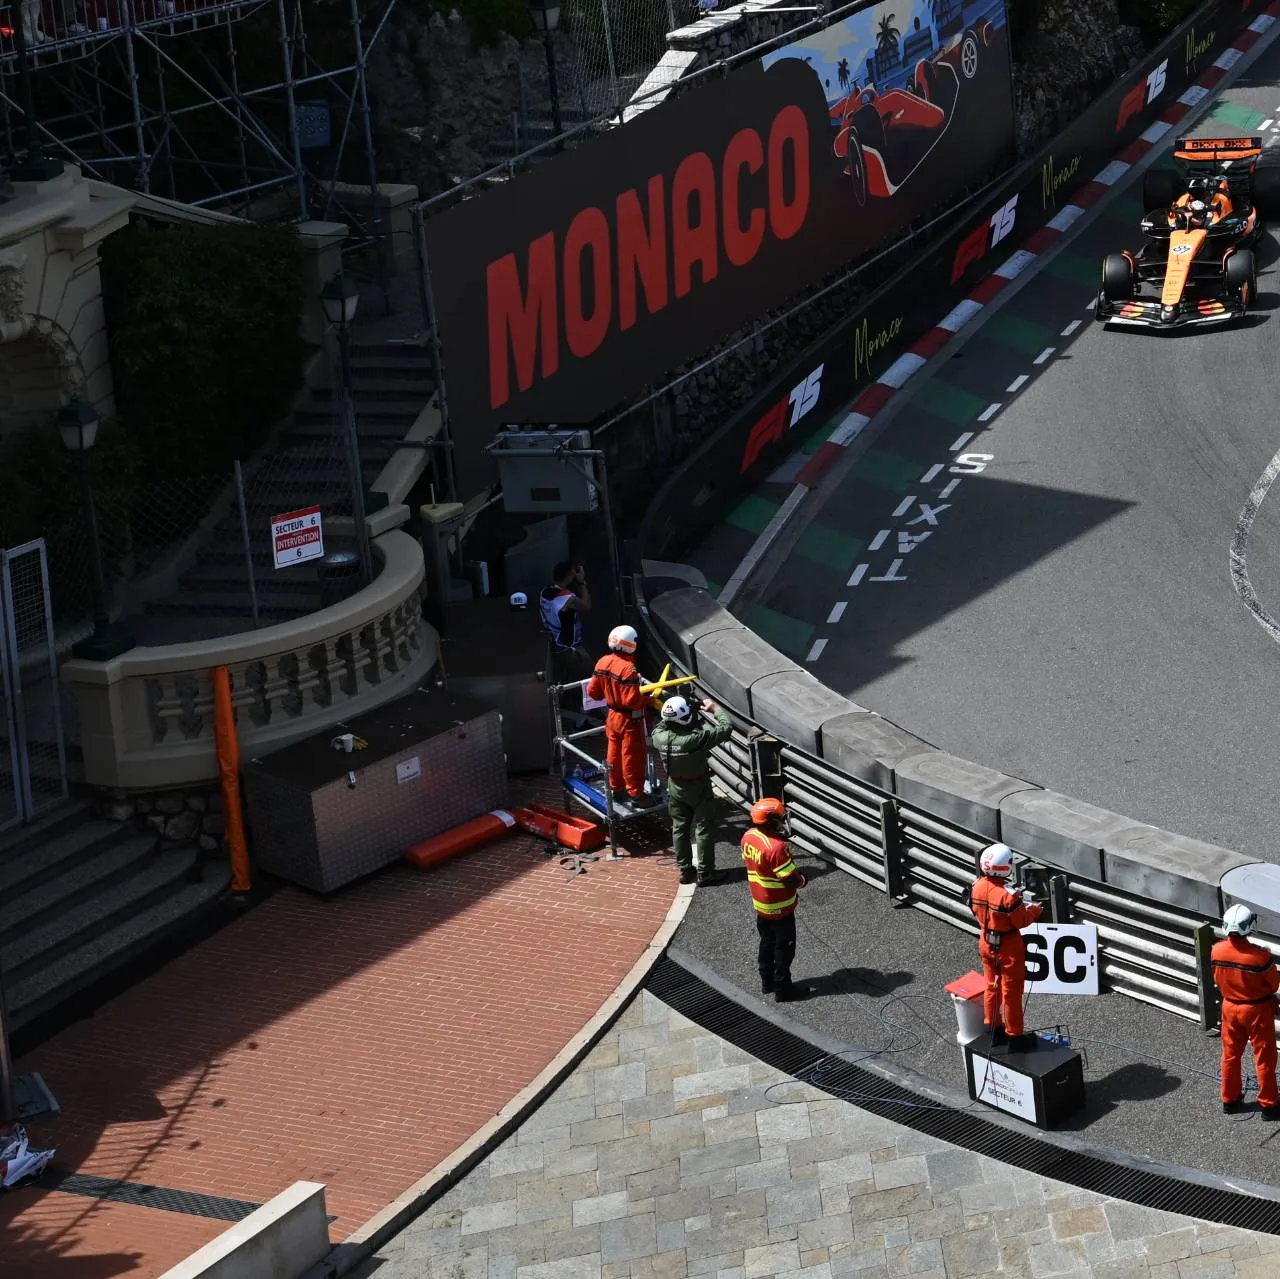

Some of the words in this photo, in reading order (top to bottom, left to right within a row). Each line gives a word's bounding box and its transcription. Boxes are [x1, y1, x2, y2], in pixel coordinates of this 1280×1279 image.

[1042, 155, 1081, 209] Monaco
[486, 105, 810, 410] MONACO
[854, 316, 904, 381] Monaco
[275, 520, 304, 534] SECTEUR
[310, 516, 316, 525] 6
[277, 530, 319, 549] INTERVENTION
[296, 548, 302, 557] 6
[1024, 934, 1087, 984] SC
[988, 1087, 1015, 1105] SECTEUR
